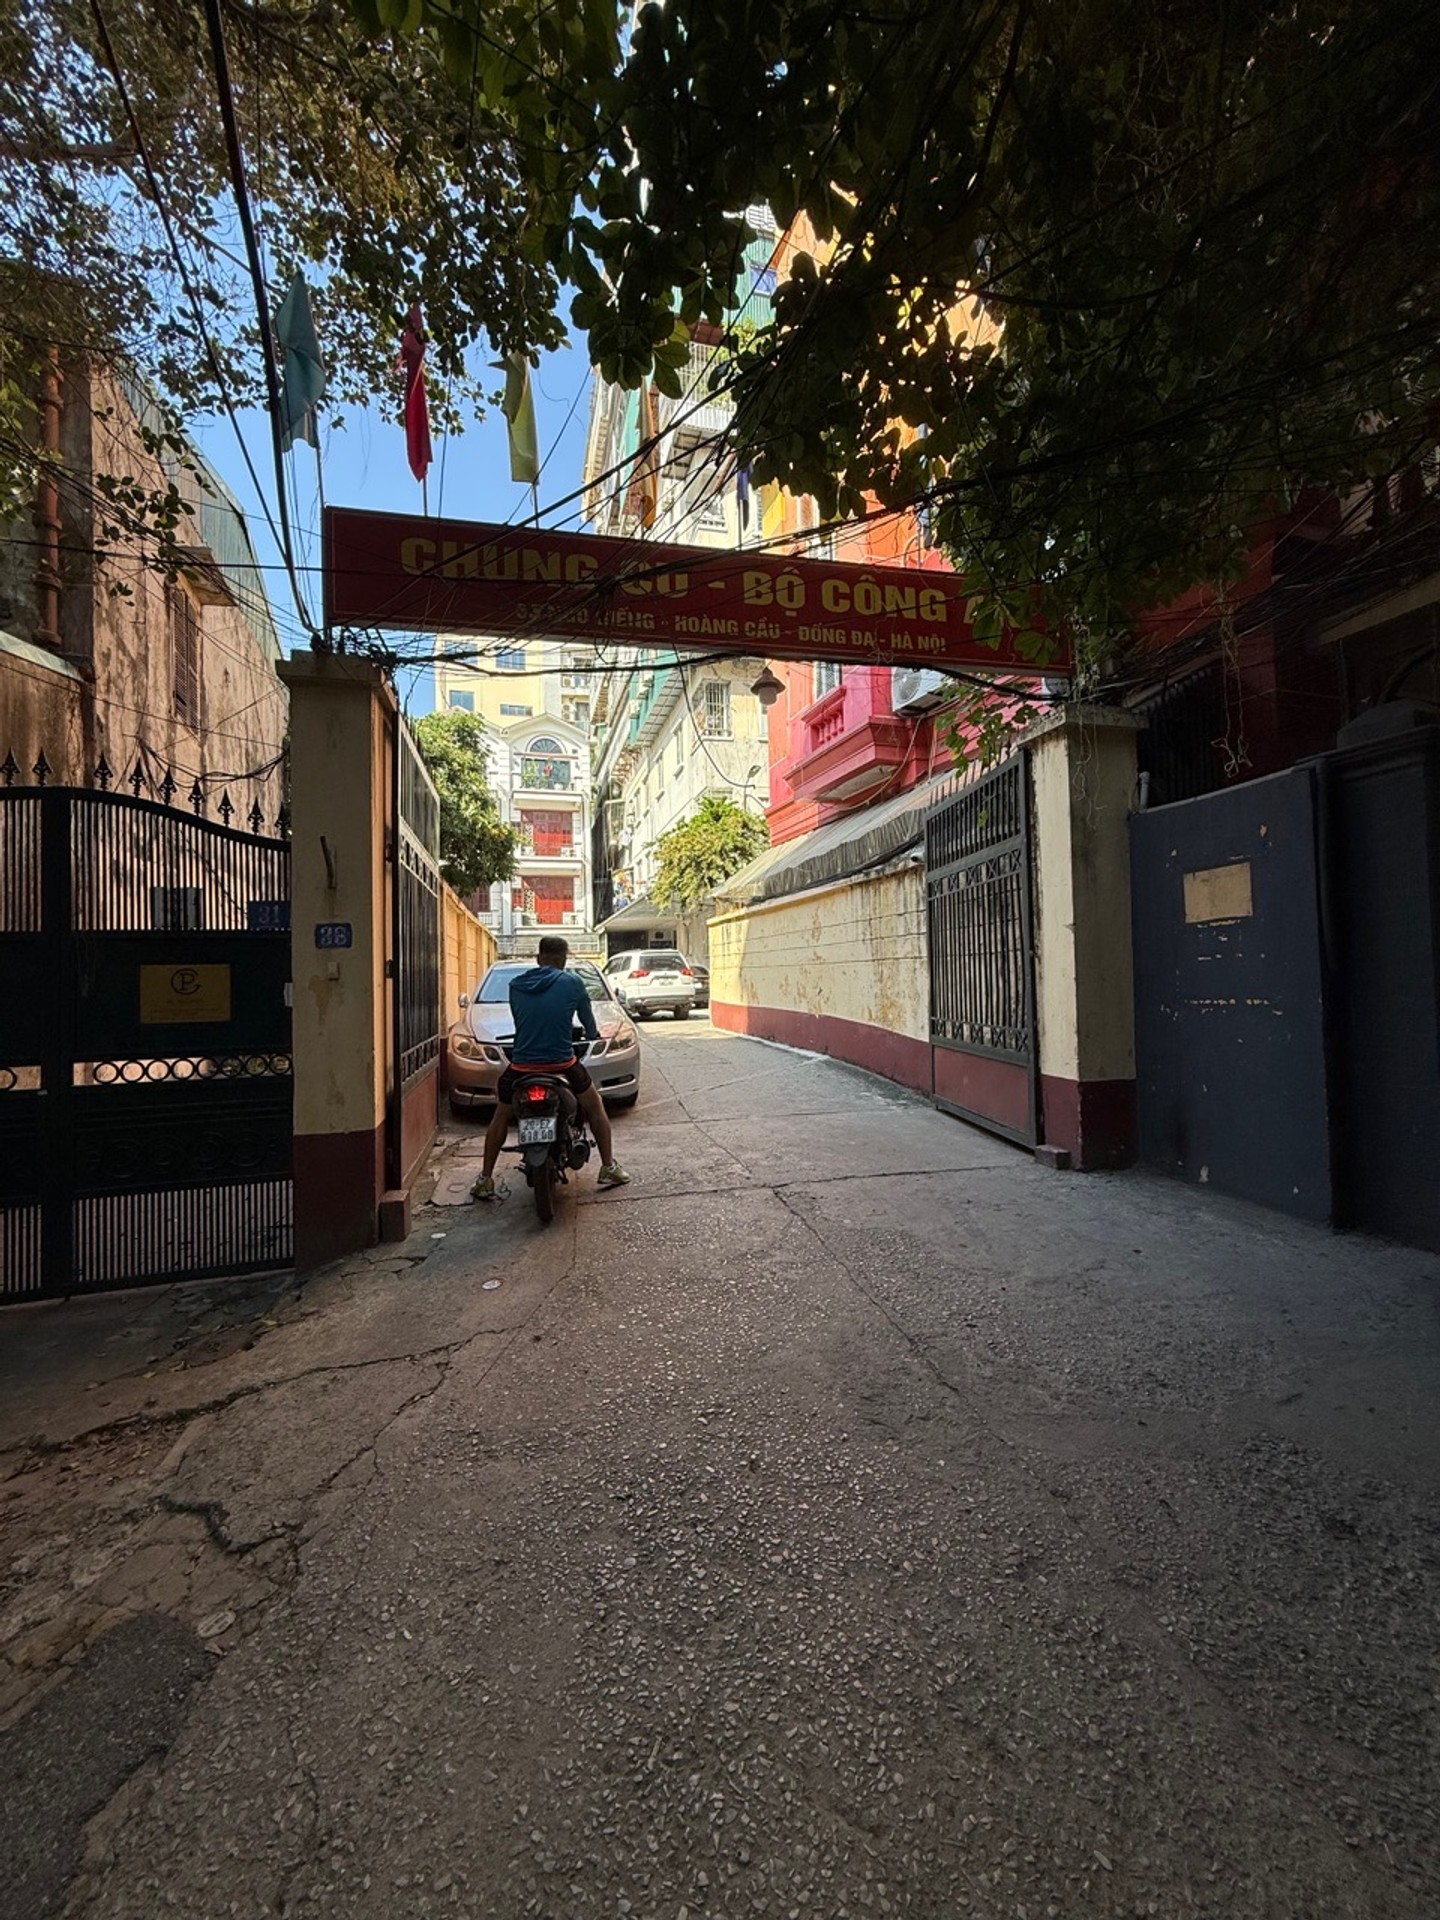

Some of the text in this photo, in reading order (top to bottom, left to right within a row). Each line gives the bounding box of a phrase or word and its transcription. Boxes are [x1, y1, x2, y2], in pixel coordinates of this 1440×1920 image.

[400, 537, 598, 588] CHUNG
[743, 566, 805, 617] BỘ
[821, 574, 947, 623] CÔNG
[675, 614, 739, 636] HOÀNG
[890, 631, 914, 650] HÀ
[917, 633, 947, 655] NỘI
[258, 905, 281, 925] 31
